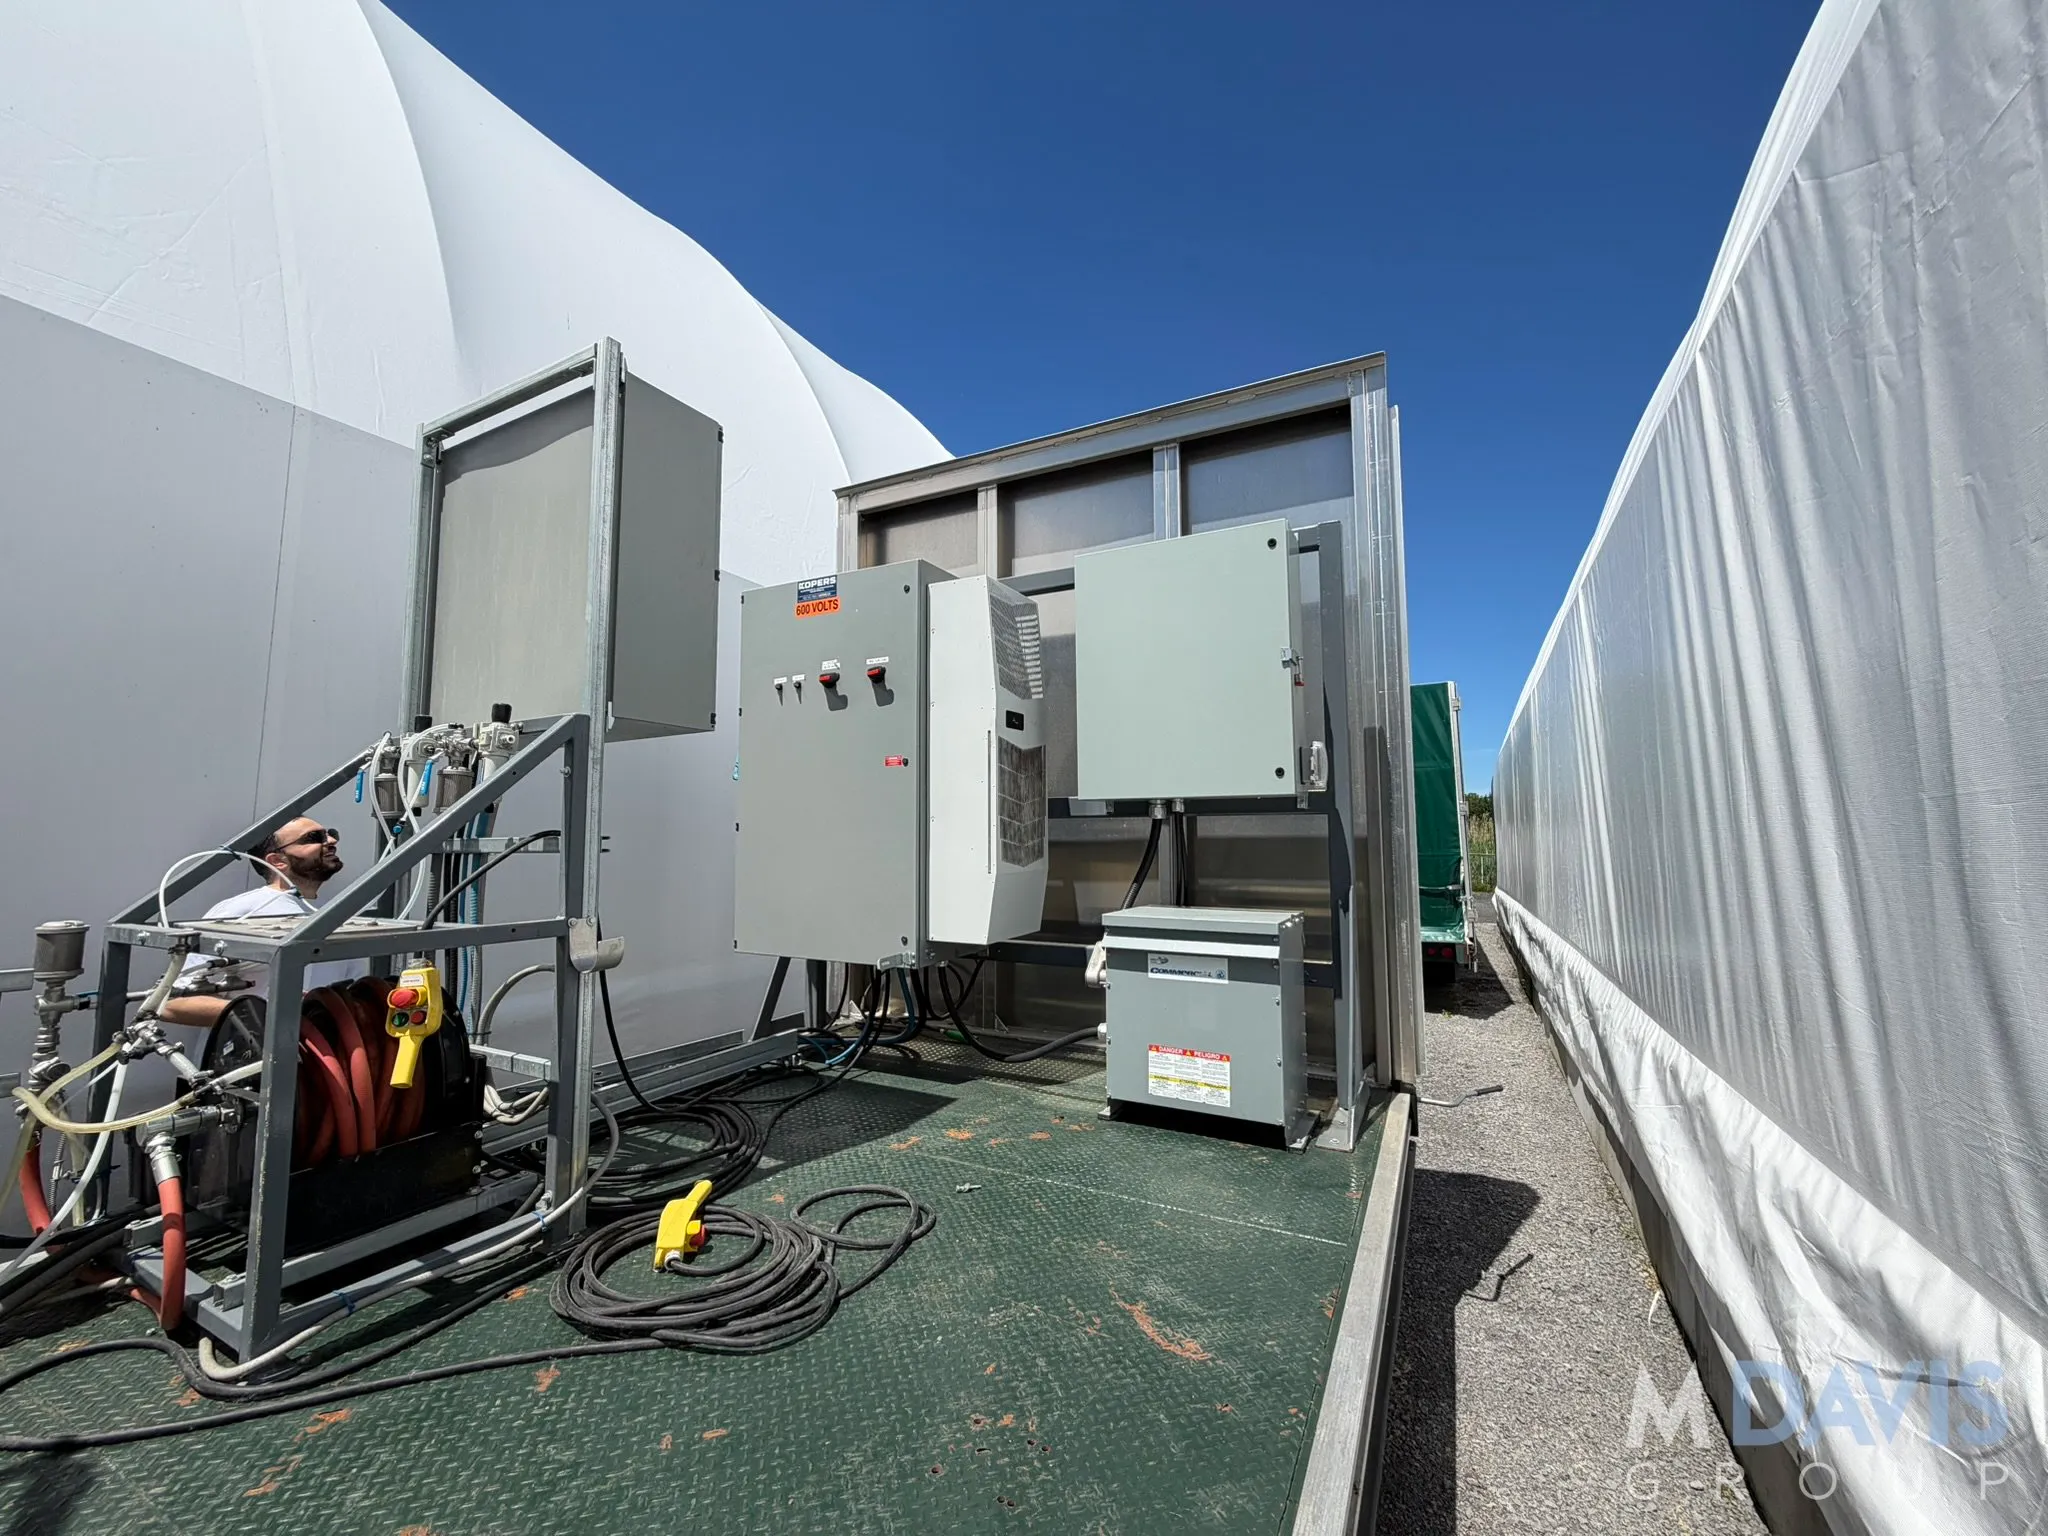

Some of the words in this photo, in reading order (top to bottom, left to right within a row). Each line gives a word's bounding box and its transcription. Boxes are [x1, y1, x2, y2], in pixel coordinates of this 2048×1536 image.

[796, 603, 810, 616] 600
[811, 599, 839, 613] VOLTS
[1158, 1046, 1183, 1055] DANGER
[1193, 1050, 1221, 1060] PELIGRO
